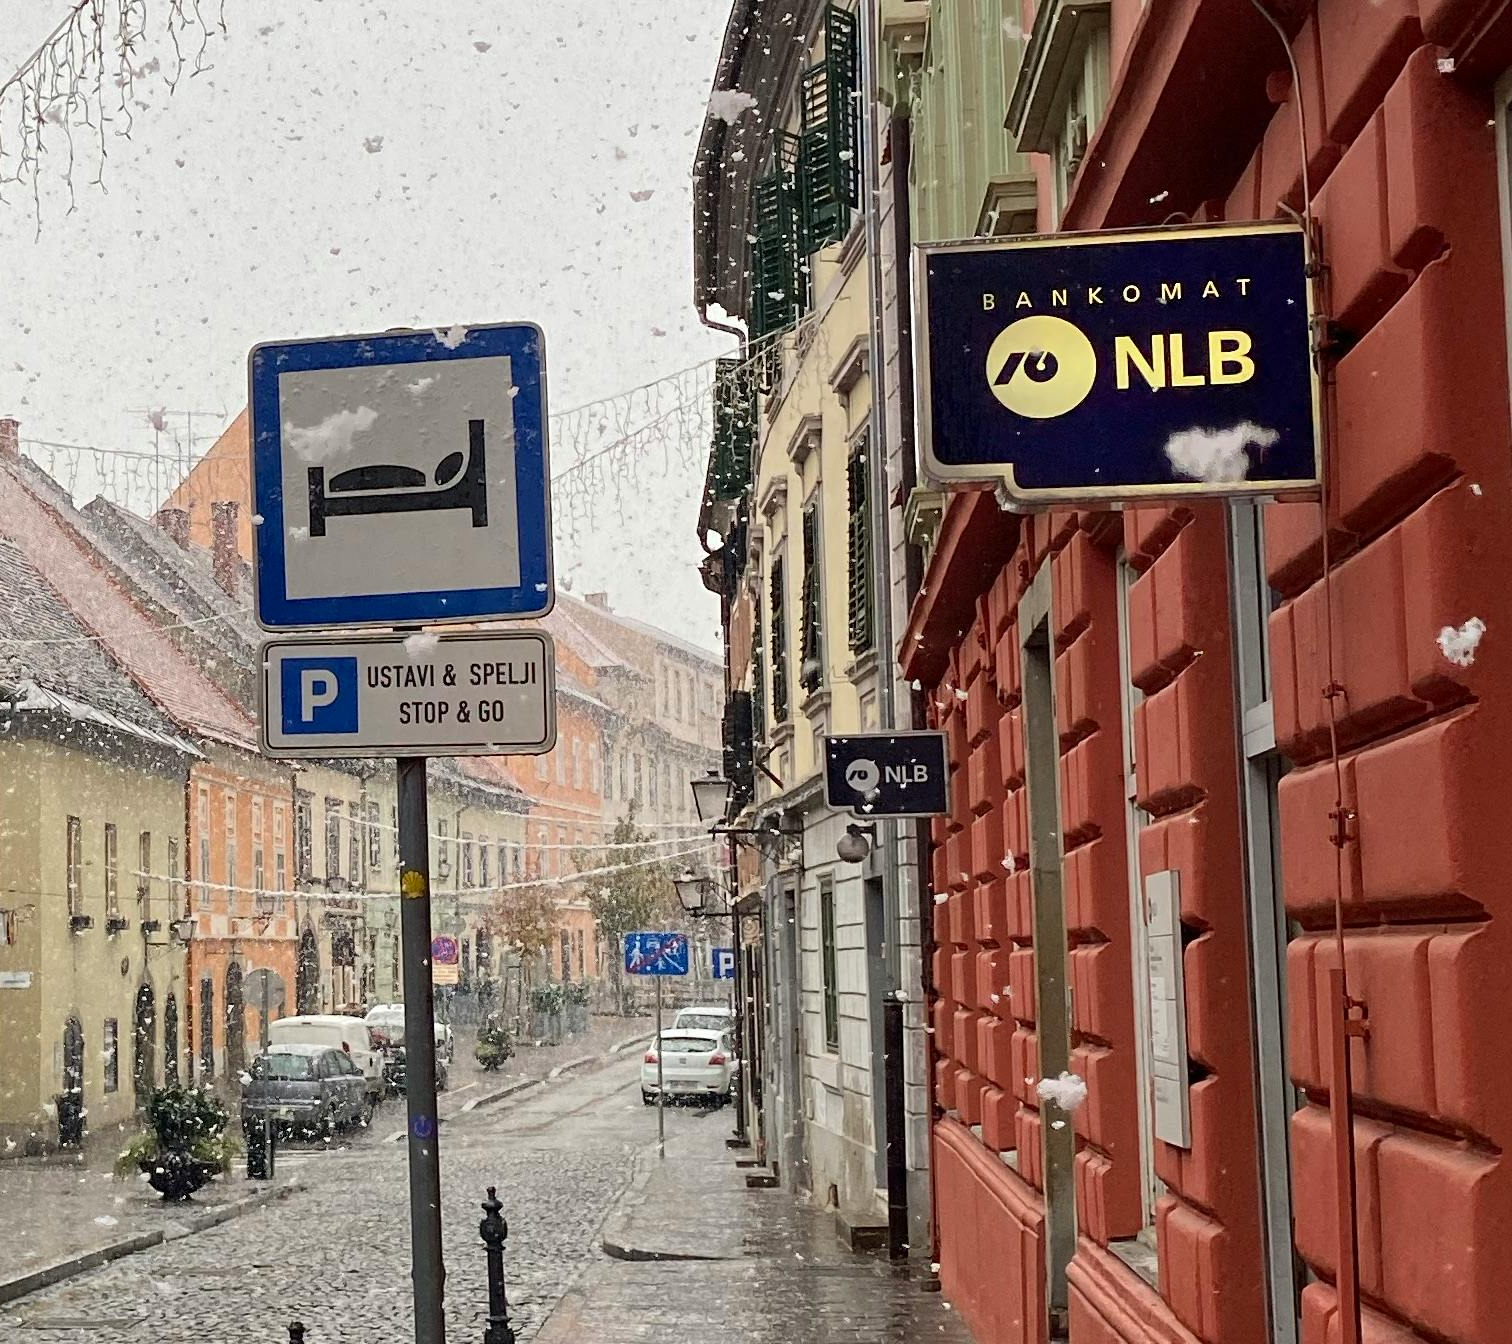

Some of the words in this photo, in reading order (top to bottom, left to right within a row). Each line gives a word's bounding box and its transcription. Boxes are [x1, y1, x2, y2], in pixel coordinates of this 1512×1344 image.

[983, 278, 1251, 311] BANKOMAT
[1115, 330, 1255, 390] NLB
[367, 664, 435, 688] USTAVI
[442, 663, 457, 687] &
[470, 661, 536, 686] SPELJI
[301, 669, 339, 722] P
[399, 701, 449, 725] STOP
[456, 700, 471, 724] &
[478, 699, 505, 723] GO
[884, 764, 929, 784] NLB
[719, 951, 735, 977] P
